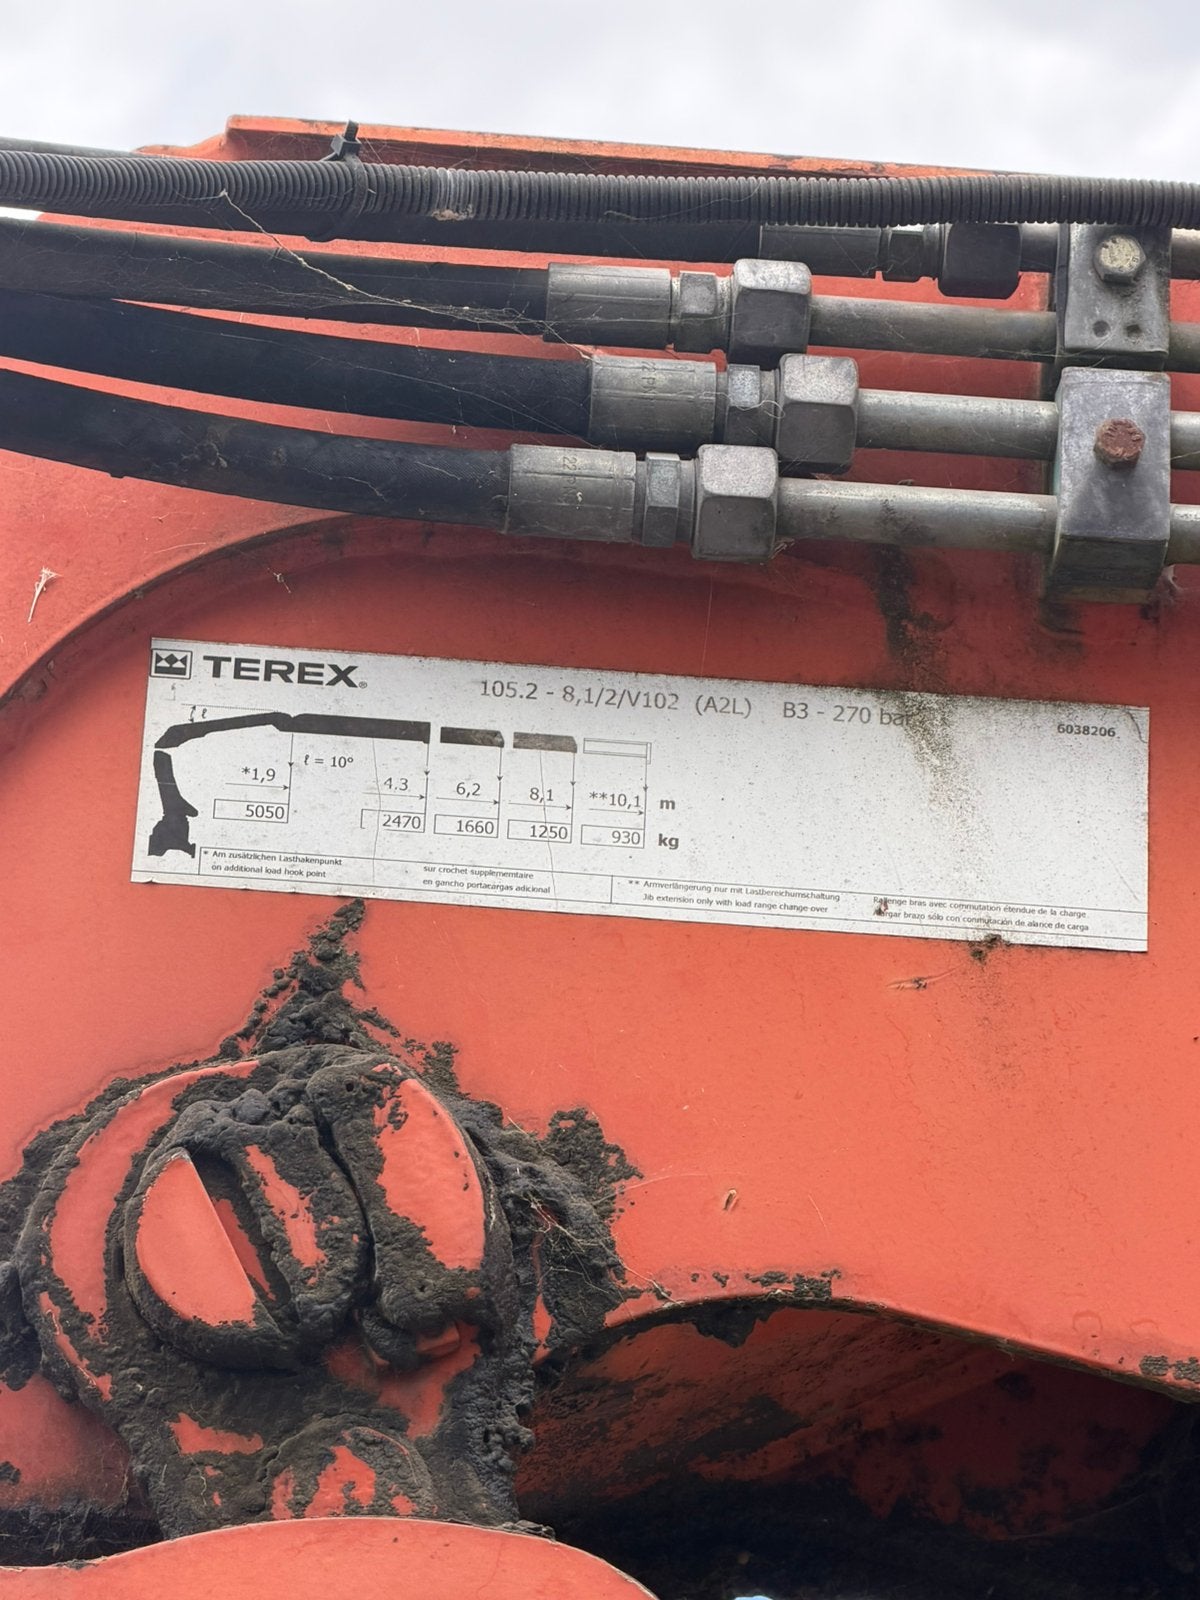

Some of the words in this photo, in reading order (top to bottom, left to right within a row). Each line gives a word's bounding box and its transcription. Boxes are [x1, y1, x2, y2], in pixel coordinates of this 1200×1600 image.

[480, 679, 538, 700] 105.2
[562, 685, 679, 710] 8,1/2/V102
[695, 694, 752, 719] (A2L)
[783, 701, 808, 719] B3
[833, 704, 871, 724] 270
[1057, 723, 1117, 738] 6038206
[456, 782, 481, 798] 6,2
[529, 787, 554, 803] 8,1
[245, 804, 285, 820] 5050
[659, 799, 676, 810] m
[382, 814, 421, 830] 2470
[456, 819, 494, 835] 1660
[529, 824, 568, 840] 1250
[611, 830, 641, 846] 930
[657, 834, 679, 850] kg
[279, 855, 342, 866] Lasthakenpunkt
[224, 864, 263, 874] additional
[265, 866, 282, 875] load
[284, 868, 303, 876] hook
[306, 870, 326, 879] point
[438, 865, 468, 875] crochet
[435, 879, 464, 888] gancho
[466, 882, 513, 893] portacargas
[515, 885, 551, 894] adicional
[643, 880, 712, 894] Armverlängerung
[730, 886, 743, 894] mit
[643, 893, 654, 901] Jib
[656, 895, 694, 904] extension
[696, 897, 713, 906] only
[715, 897, 733, 906] with
[735, 899, 752, 907] load
[754, 902, 777, 910] range
[909, 898, 927, 907] bras
[929, 901, 947, 909] avec
[949, 902, 1001, 911] commutation
[1037, 907, 1048, 915] de
[1059, 910, 1087, 919] charge
[903, 911, 925, 920] brazo
[1015, 919, 1026, 927] de
[1067, 924, 1089, 932] carga
